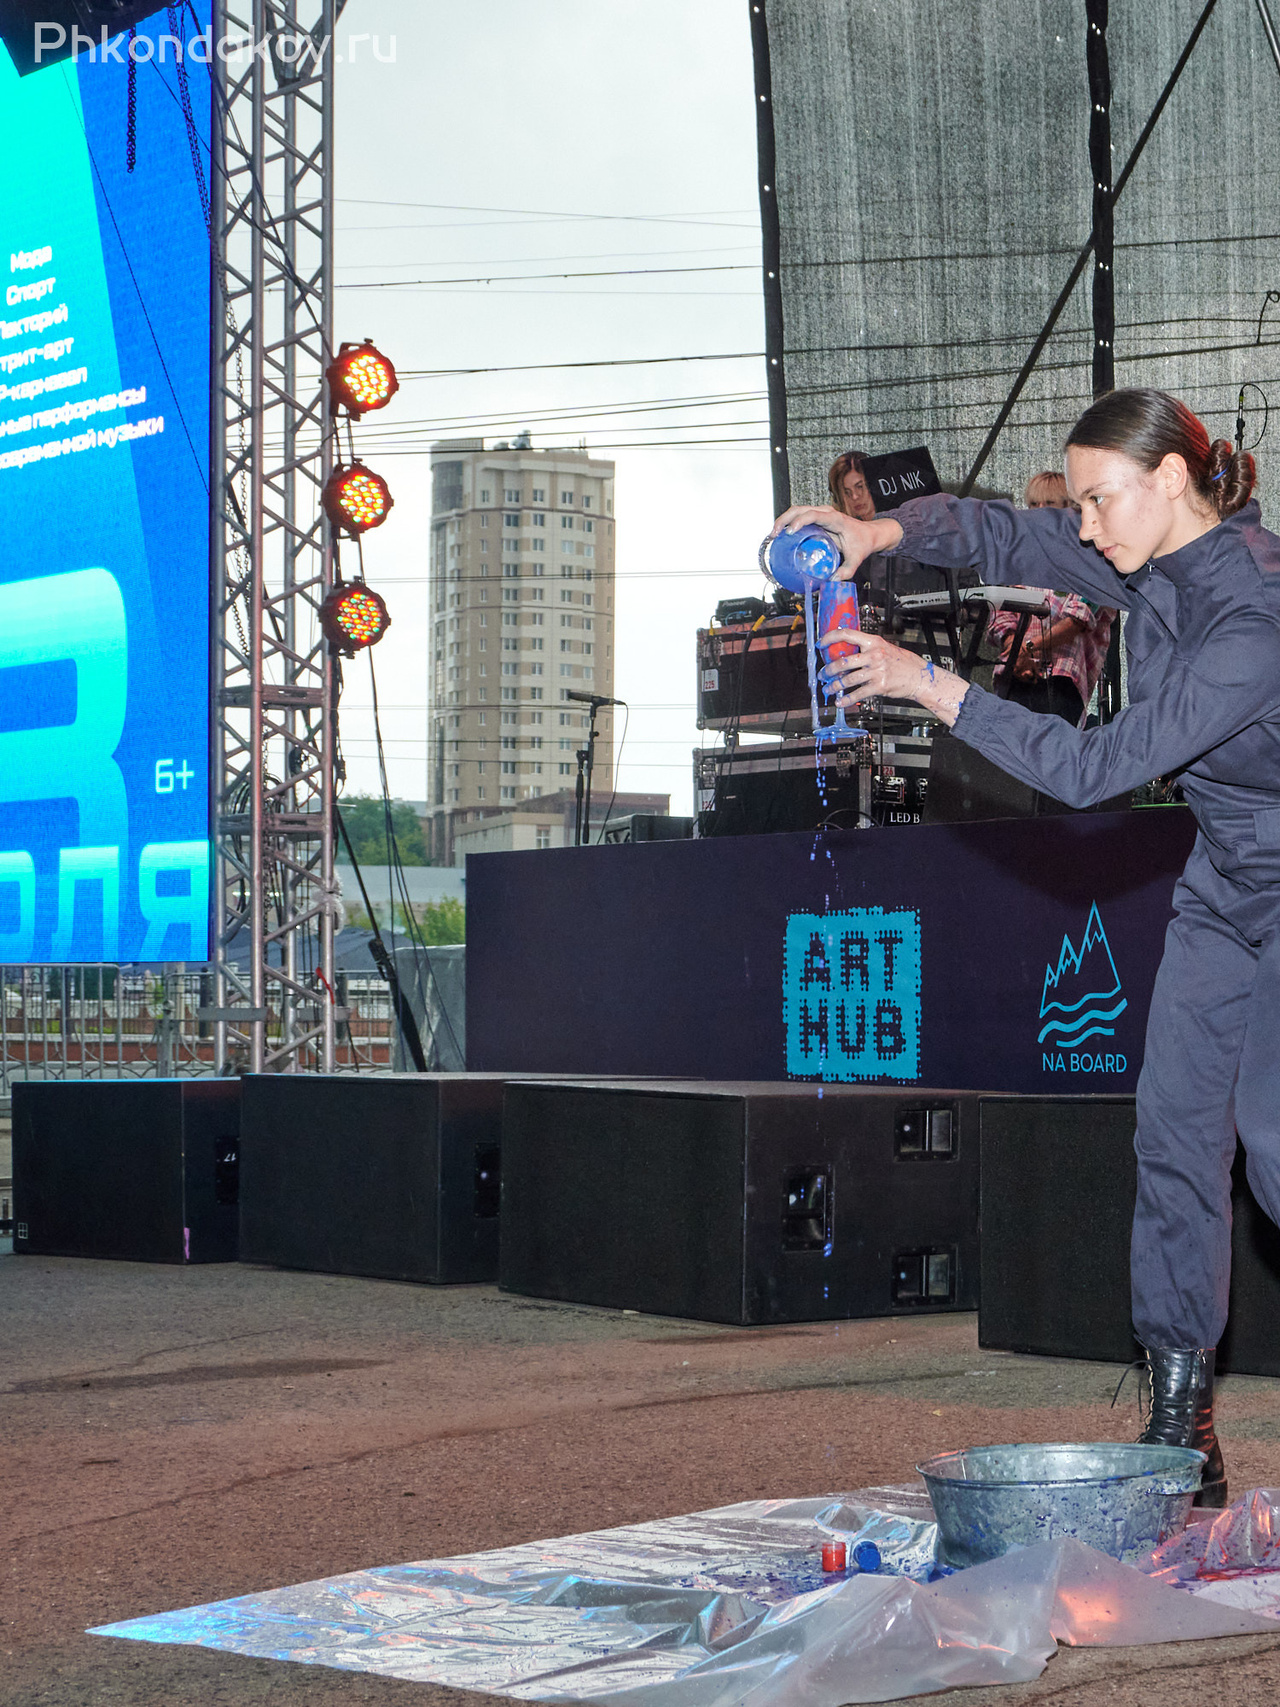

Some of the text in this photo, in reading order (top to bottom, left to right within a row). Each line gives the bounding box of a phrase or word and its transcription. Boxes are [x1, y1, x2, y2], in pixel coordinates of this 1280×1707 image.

[10, 246, 52, 273] Мода
[6, 277, 56, 306] Спорт
[878, 470, 926, 496] DJ NIK
[155, 758, 195, 794] 6+
[890, 812, 911, 824] LED
[800, 930, 904, 992] ART
[800, 998, 907, 1061] HUB
[1042, 1053, 1128, 1073] NA BOARD
